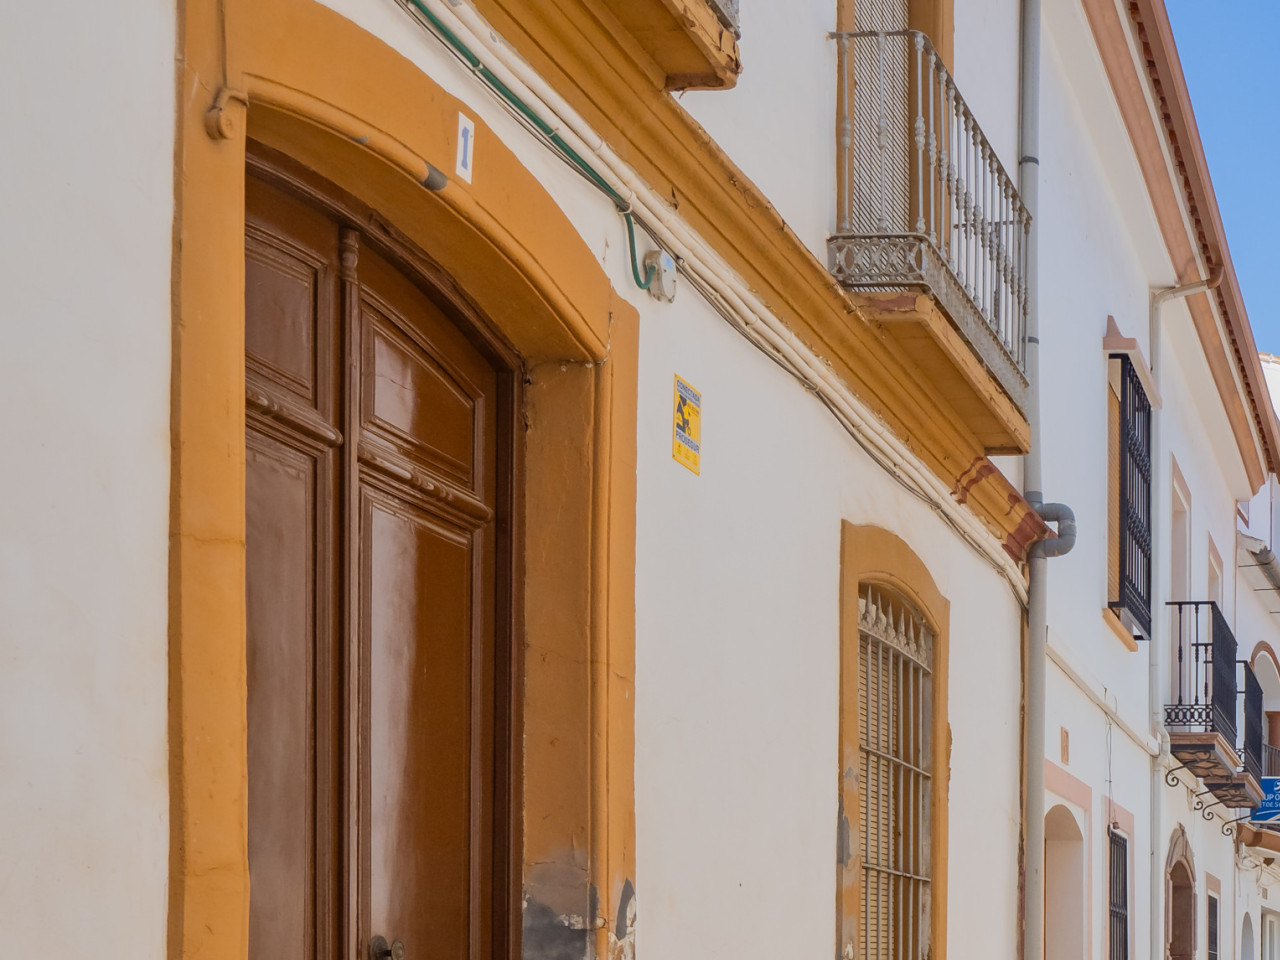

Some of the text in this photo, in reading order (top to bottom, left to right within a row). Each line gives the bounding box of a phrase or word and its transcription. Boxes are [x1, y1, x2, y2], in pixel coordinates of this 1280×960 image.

[461, 126, 470, 170] 1
[677, 379, 700, 402] CONECTADA
[675, 430, 700, 454] PROSEGUR
